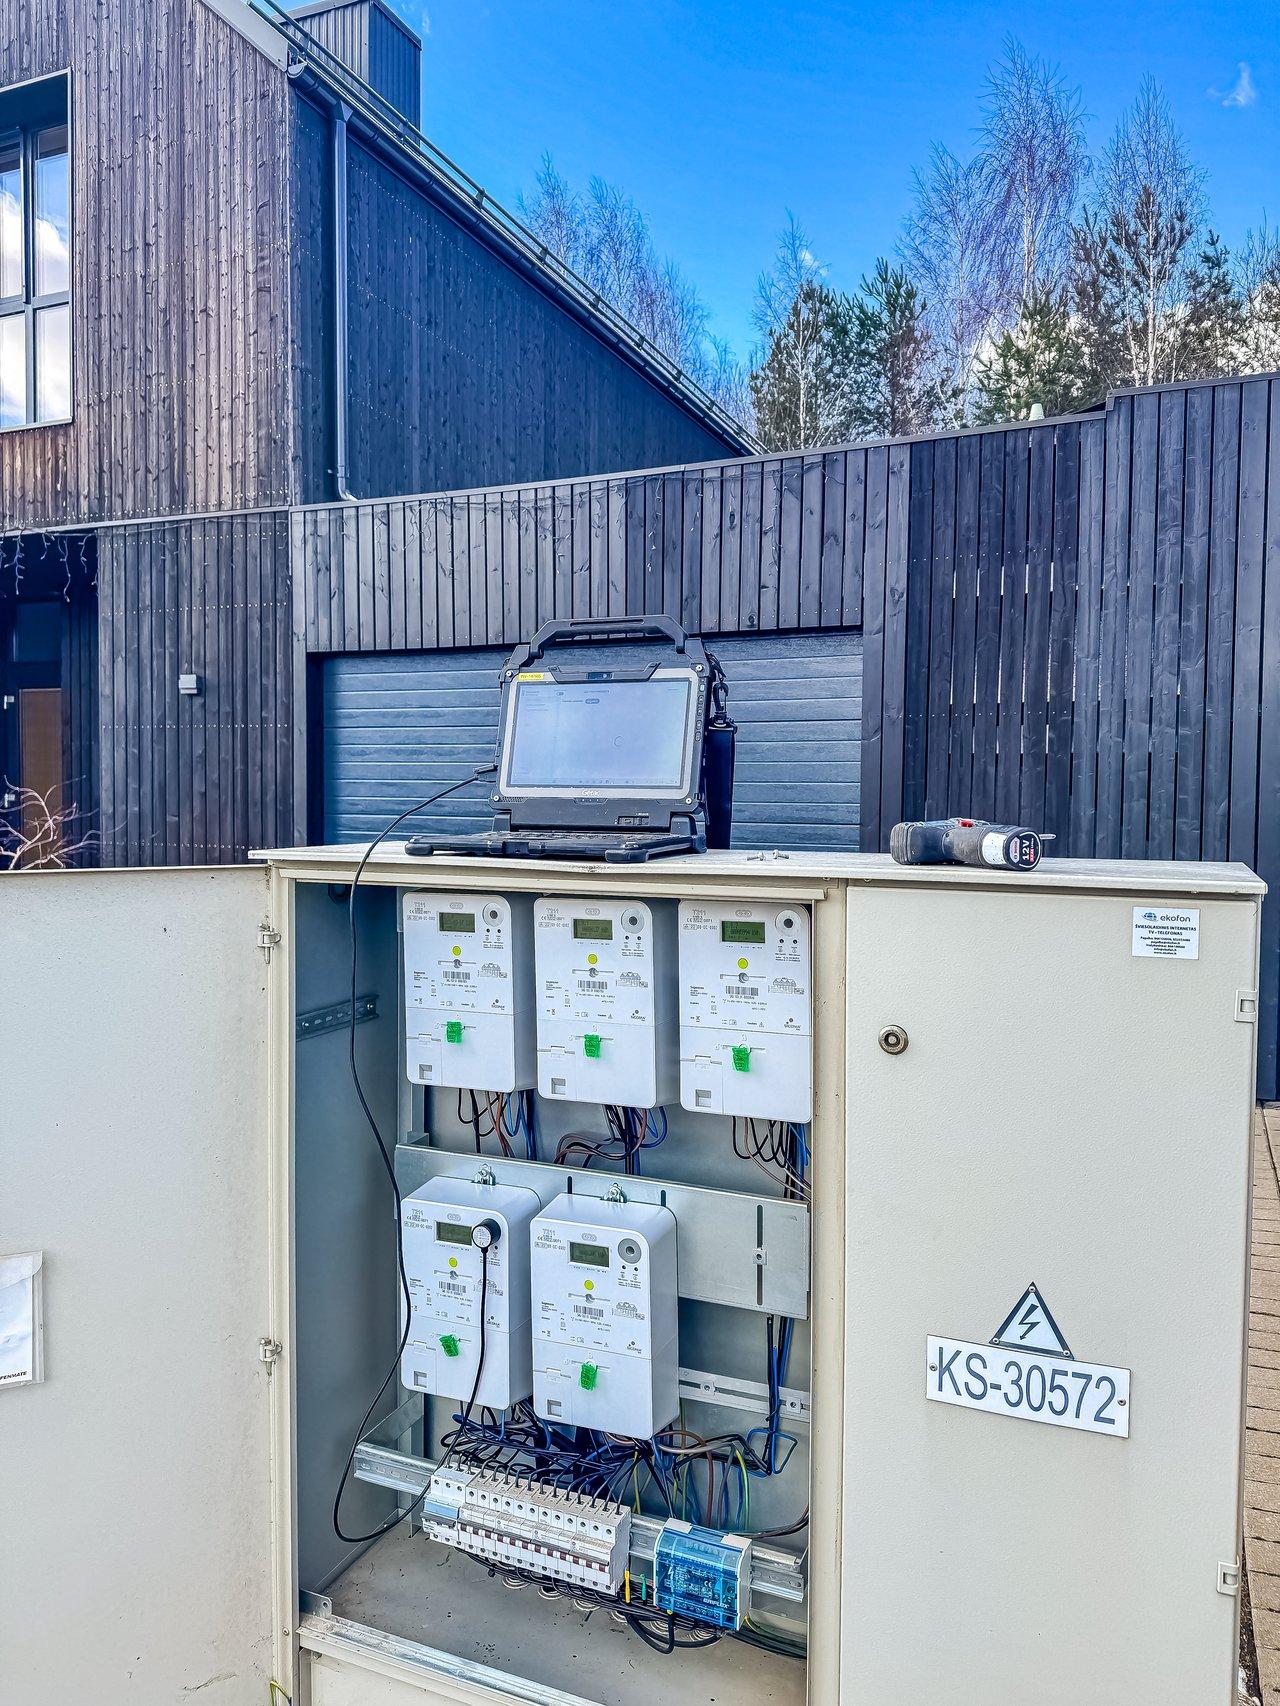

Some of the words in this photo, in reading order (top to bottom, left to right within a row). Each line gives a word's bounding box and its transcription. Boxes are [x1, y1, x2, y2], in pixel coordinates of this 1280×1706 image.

[1022, 839, 1030, 861] 12V
[1160, 914, 1191, 923] ekofon
[938, 1346, 1116, 1425] KS-30572
